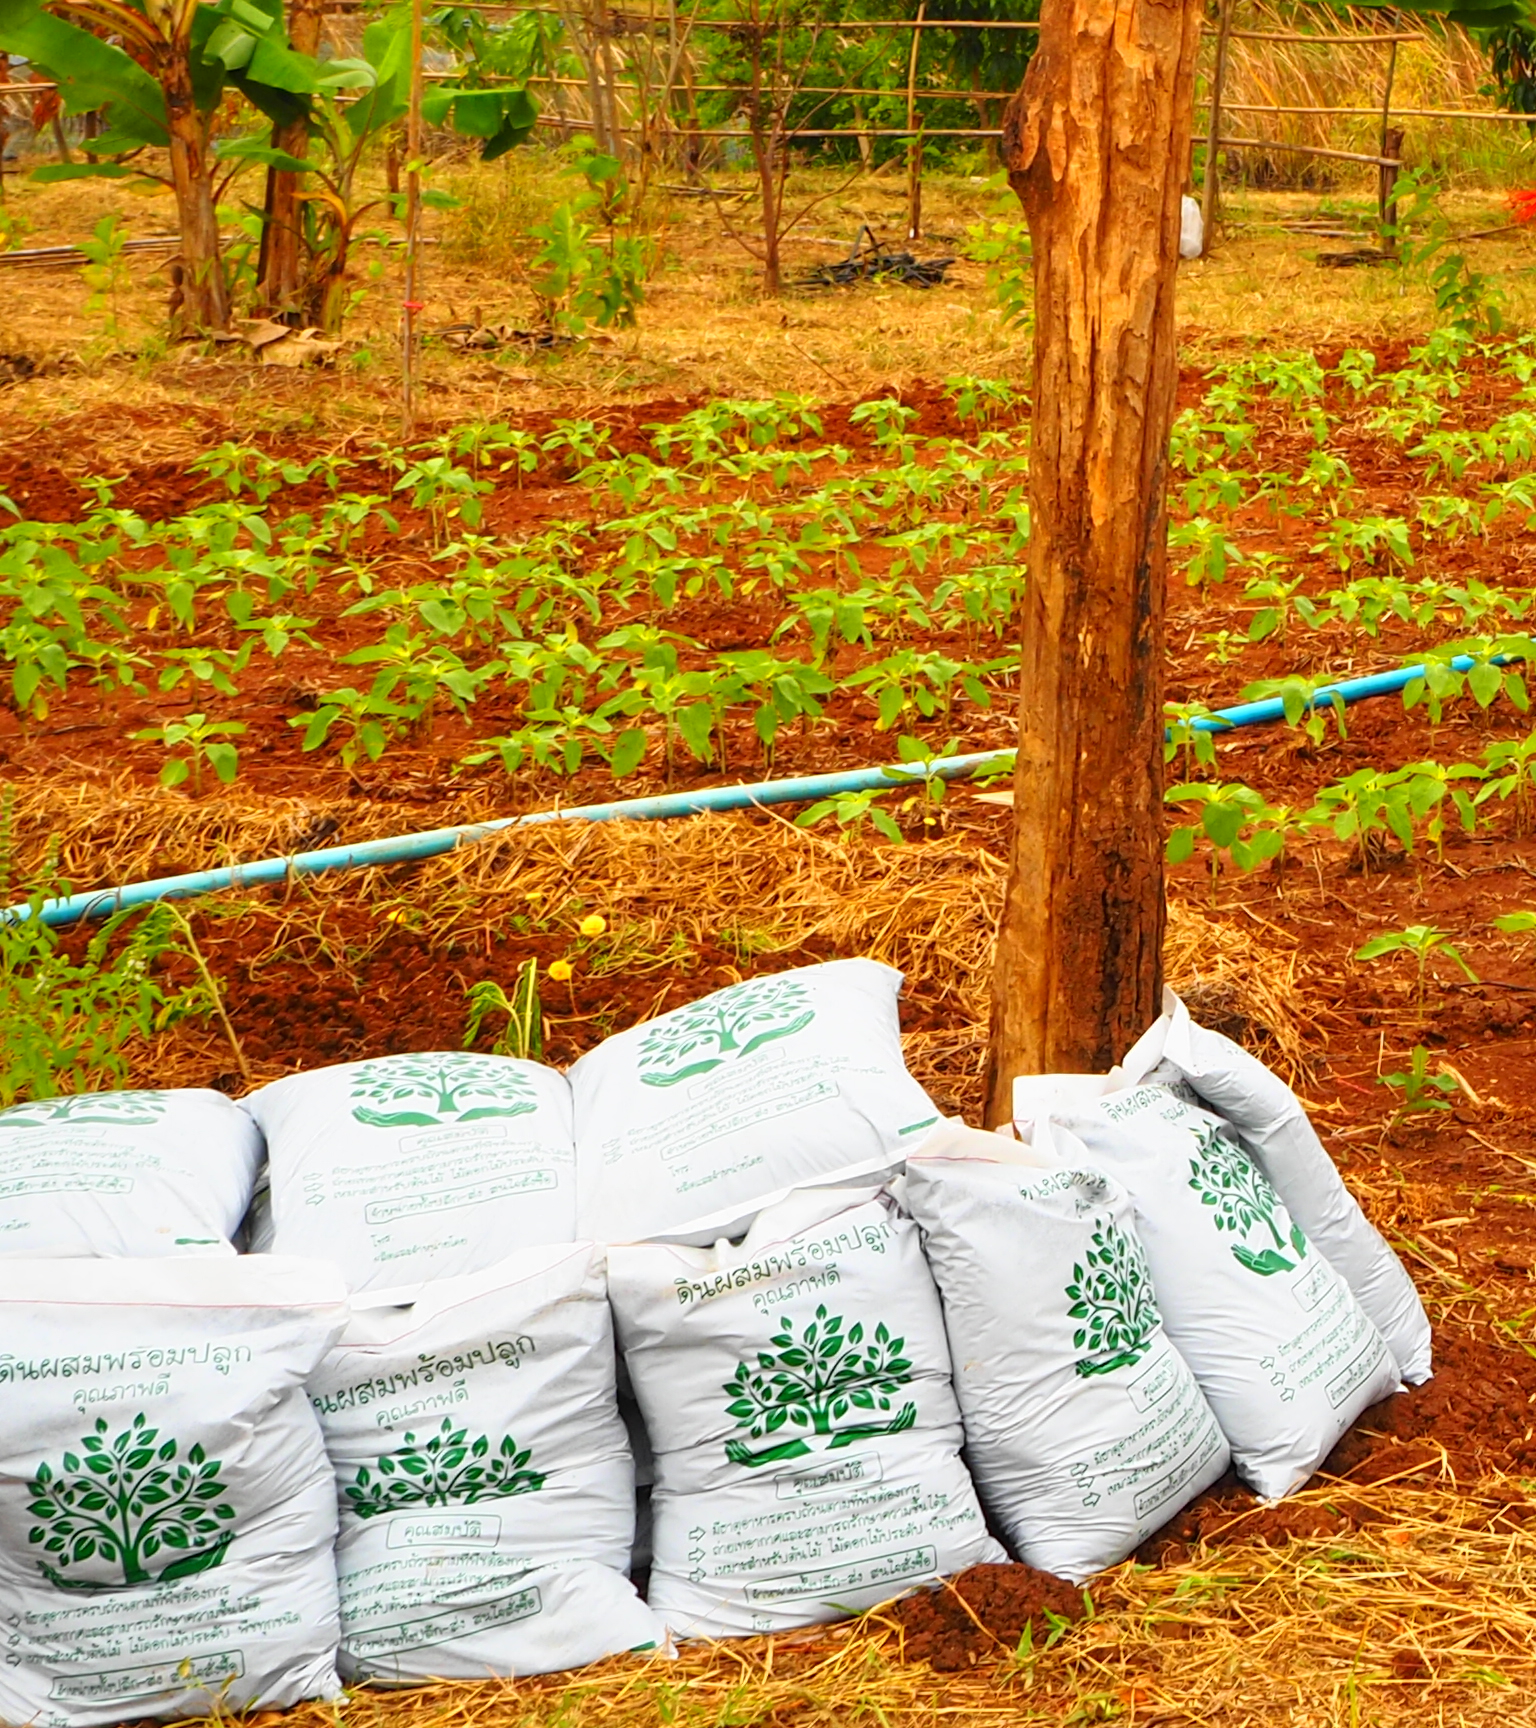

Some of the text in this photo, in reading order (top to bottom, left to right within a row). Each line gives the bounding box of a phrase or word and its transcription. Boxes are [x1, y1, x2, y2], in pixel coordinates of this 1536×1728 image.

[674, 1221, 898, 1305] ดินผสมพร้อมปลูก
[752, 1263, 841, 1316] คุณภาพดี
[73, 1372, 170, 1414] คุณภาพดี
[376, 1379, 469, 1431] คุณภาพดี
